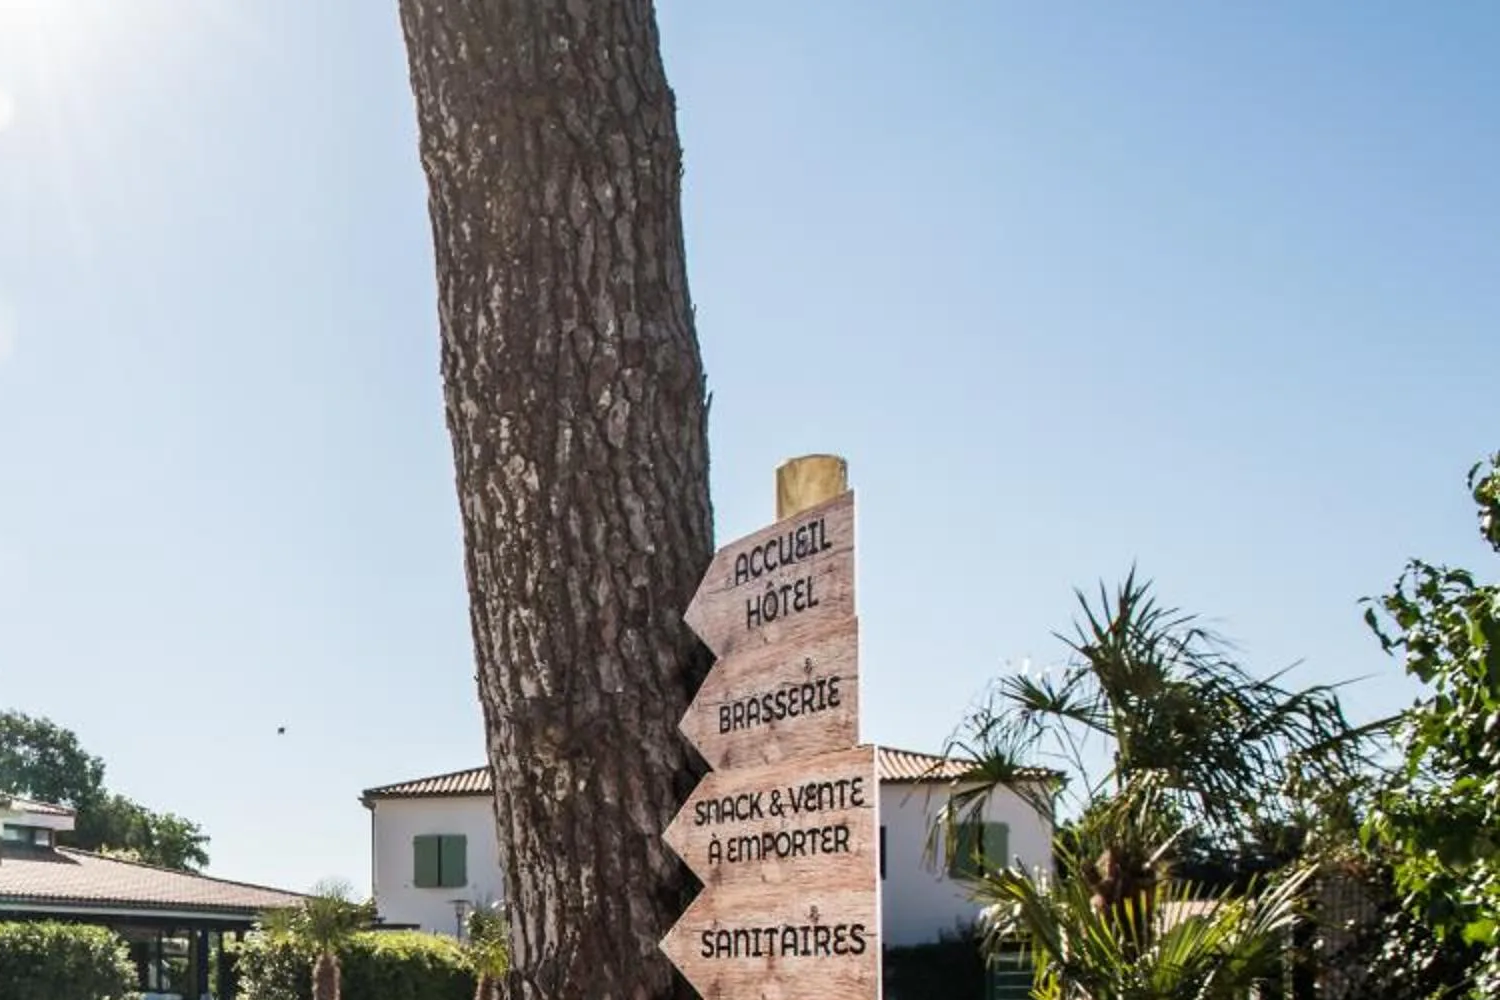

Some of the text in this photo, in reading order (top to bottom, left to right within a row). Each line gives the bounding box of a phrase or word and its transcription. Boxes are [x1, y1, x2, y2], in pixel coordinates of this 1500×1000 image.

[734, 518, 833, 586] ACCUEIL
[746, 575, 820, 630] HÔTEL
[718, 676, 842, 735] BRASSERIE
[694, 776, 866, 827] SNACK & VENTE
[707, 823, 851, 865] À EMPORTER
[700, 922, 867, 959] SANITAIRES
